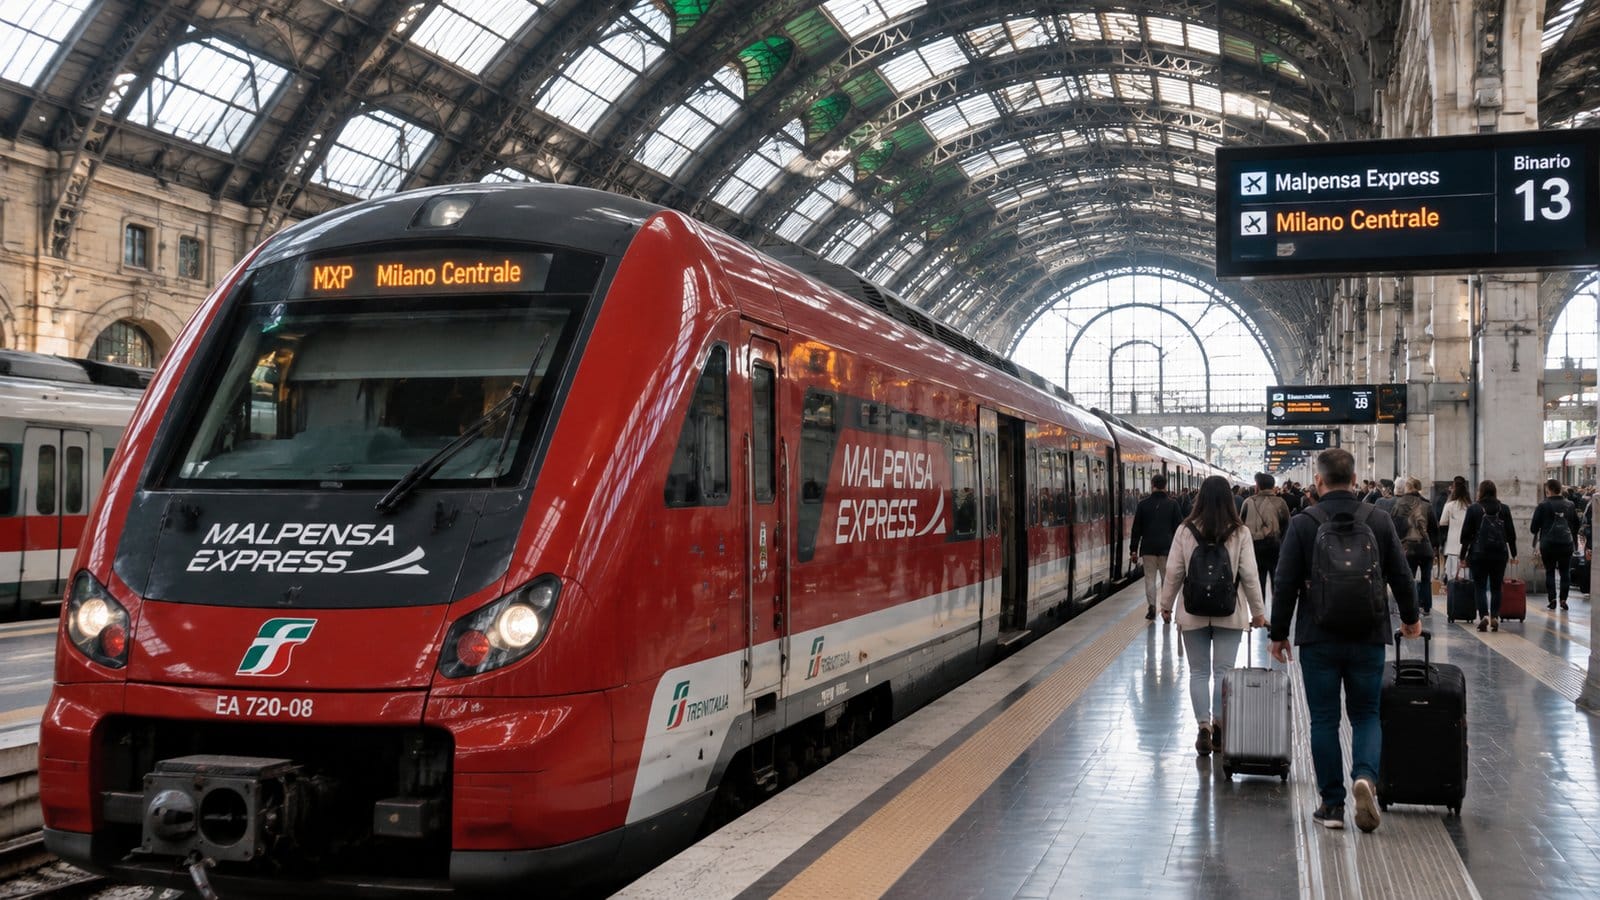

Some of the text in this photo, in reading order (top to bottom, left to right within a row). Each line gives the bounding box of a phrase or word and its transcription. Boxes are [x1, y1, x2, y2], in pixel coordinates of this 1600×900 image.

[1513, 153, 1571, 171] Binario
[1275, 168, 1440, 194] Malpensa Express
[1514, 177, 1572, 221] 13
[1276, 206, 1440, 233] Milano Centrale
[313, 259, 521, 290] MXP Milano Centrale
[841, 443, 933, 489] MALPENSA
[202, 522, 394, 546] MALPENSA
[835, 499, 918, 544] EXPRESS
[186, 549, 354, 573] EXPRESS
[215, 695, 313, 718] EA 720-08
